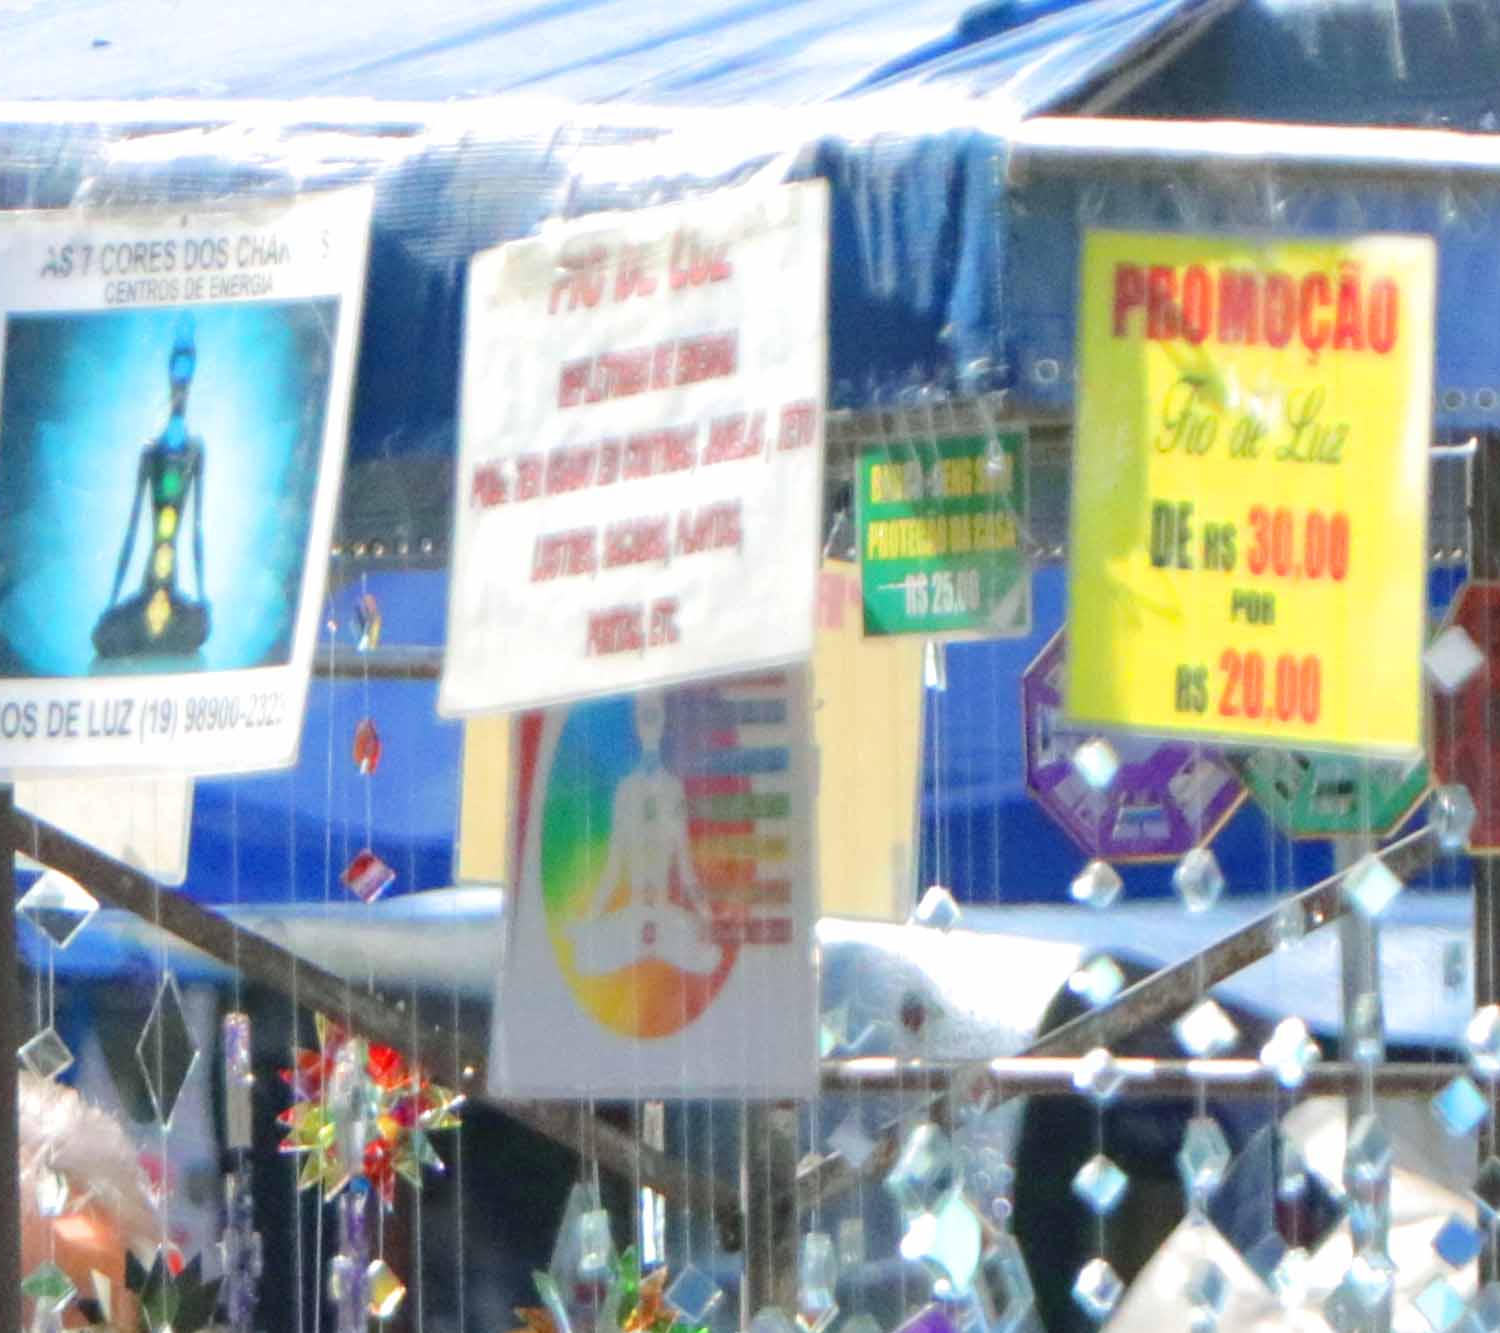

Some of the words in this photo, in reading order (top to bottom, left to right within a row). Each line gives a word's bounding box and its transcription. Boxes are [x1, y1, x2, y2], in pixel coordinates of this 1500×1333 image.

[40, 246, 74, 279] AS
[81, 247, 94, 275] 7
[100, 240, 177, 276] CORES
[183, 237, 228, 271] DOS
[104, 278, 179, 305] CENTROS
[184, 277, 207, 301] DE
[209, 274, 273, 299] ENERGIA
[1111, 260, 1400, 366] PROMOÇÃO
[1154, 375, 1217, 455] Fio
[1275, 385, 1351, 465] Luz
[1151, 500, 1193, 570] DE
[1203, 521, 1236, 573] R$
[1248, 504, 1350, 582] 30,00
[1231, 588, 1275, 626] POR
[1175, 664, 1208, 715] R$
[1218, 648, 1322, 725] 20,00
[47, 700, 81, 738] DE
[87, 698, 134, 736] LUZ
[139, 698, 178, 744] (19)
